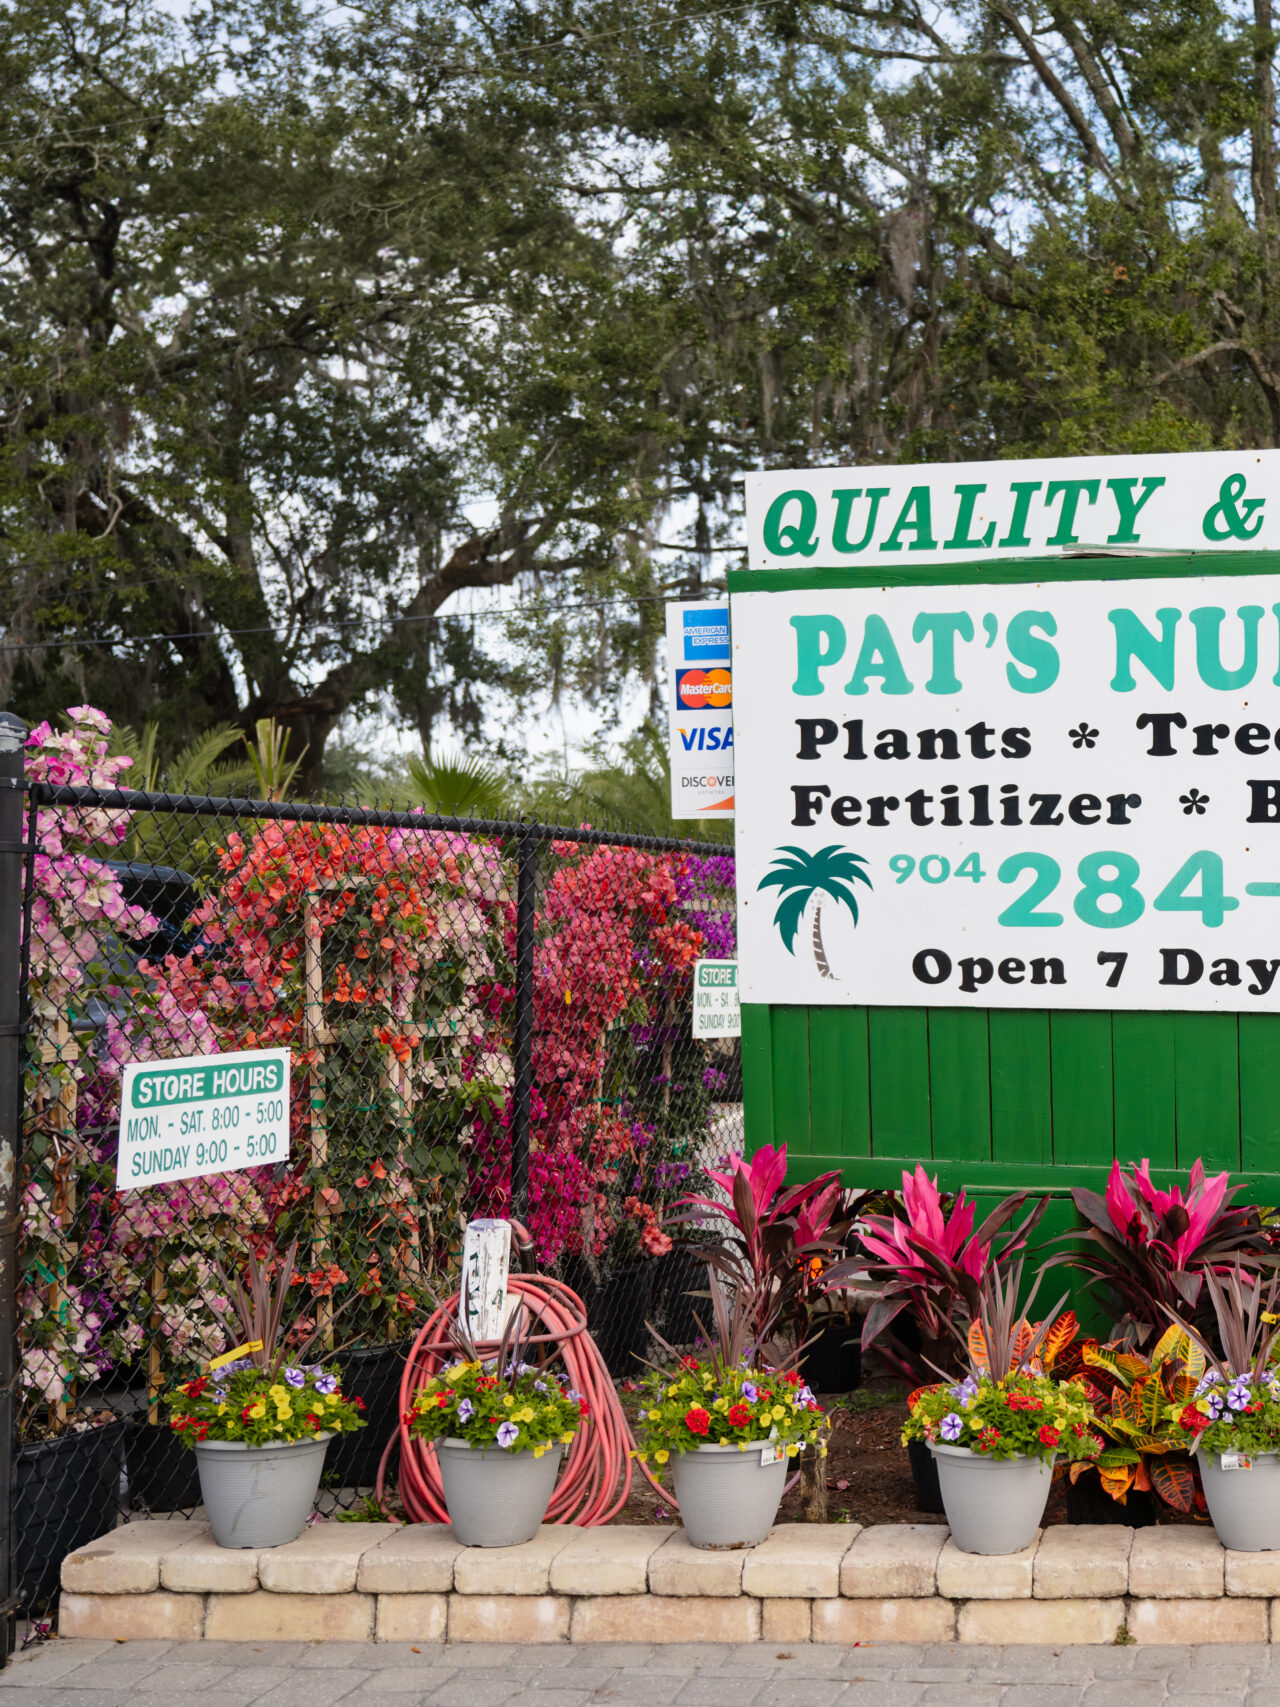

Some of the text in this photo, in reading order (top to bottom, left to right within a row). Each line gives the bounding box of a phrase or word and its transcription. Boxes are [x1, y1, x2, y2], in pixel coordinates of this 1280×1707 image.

[763, 476, 1166, 557] QUALITY
[1202, 472, 1266, 541] &
[684, 626, 726, 635] AMERICAN
[790, 610, 1060, 696] PAT'S
[676, 727, 733, 751] VISA
[795, 718, 1031, 760] Plants
[790, 784, 1142, 826] Fertilizer
[889, 852, 986, 885] 904
[701, 968, 732, 984] STORE
[912, 948, 1067, 993] Open
[1097, 951, 1128, 987] 7
[699, 1013, 725, 1030] SUNDAY
[138, 1065, 278, 1104] STORE HOURS
[127, 1115, 161, 1143] MON.
[180, 1109, 206, 1135] SAT.
[212, 1105, 240, 1130] 8:00
[256, 1099, 283, 1124] 5:00
[131, 1145, 191, 1177] SUNDAY
[196, 1139, 228, 1166] 9:00
[246, 1132, 277, 1157] 5:00
